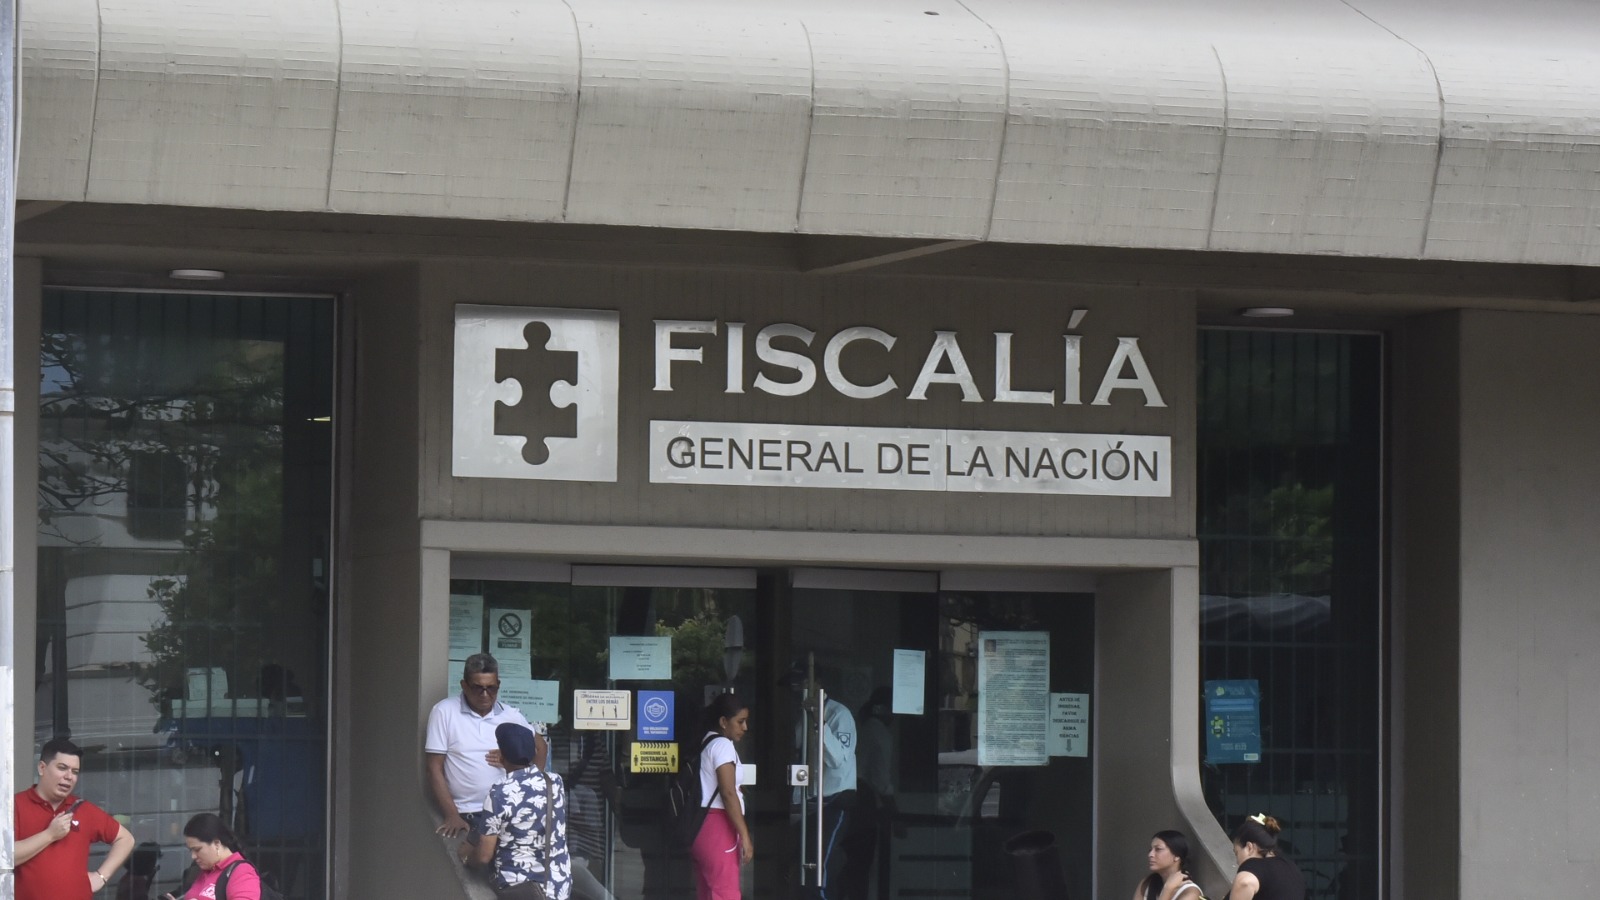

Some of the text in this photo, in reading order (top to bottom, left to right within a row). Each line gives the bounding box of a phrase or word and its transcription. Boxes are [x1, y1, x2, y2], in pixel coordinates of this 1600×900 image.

[652, 310, 1168, 408] FISCALÍA
[666, 435, 1158, 482] GENERAL DE LA NACIÓN
